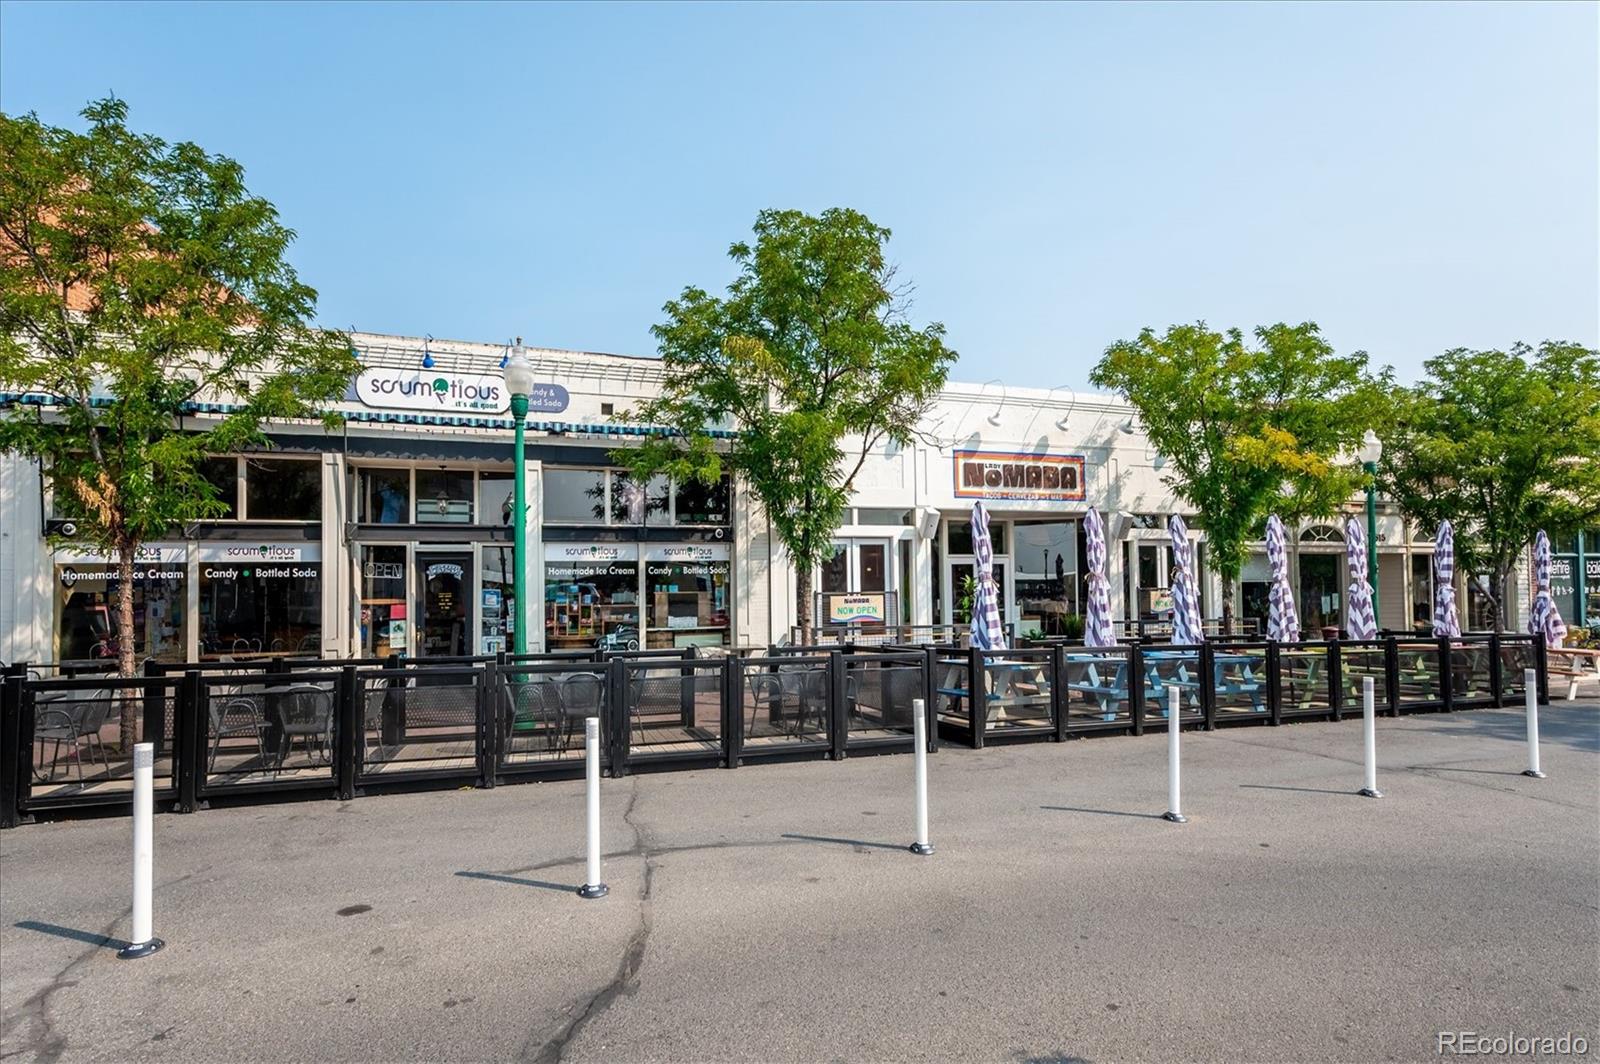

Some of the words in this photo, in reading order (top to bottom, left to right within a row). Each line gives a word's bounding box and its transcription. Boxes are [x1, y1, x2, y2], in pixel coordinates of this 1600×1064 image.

[61, 568, 120, 580] Homemad
[132, 570, 145, 579] ce
[147, 570, 184, 579] Cream
[204, 568, 239, 580] Candy
[255, 568, 290, 578] Bottled
[292, 568, 317, 578] Soda
[366, 564, 402, 577] OPEN
[548, 566, 594, 575] Homemade
[596, 566, 608, 575] Ice
[609, 566, 635, 575] Cream
[648, 565, 672, 576] Candy
[682, 566, 708, 575] Bottled
[709, 565, 727, 575] Soda
[837, 607, 854, 615] NOW
